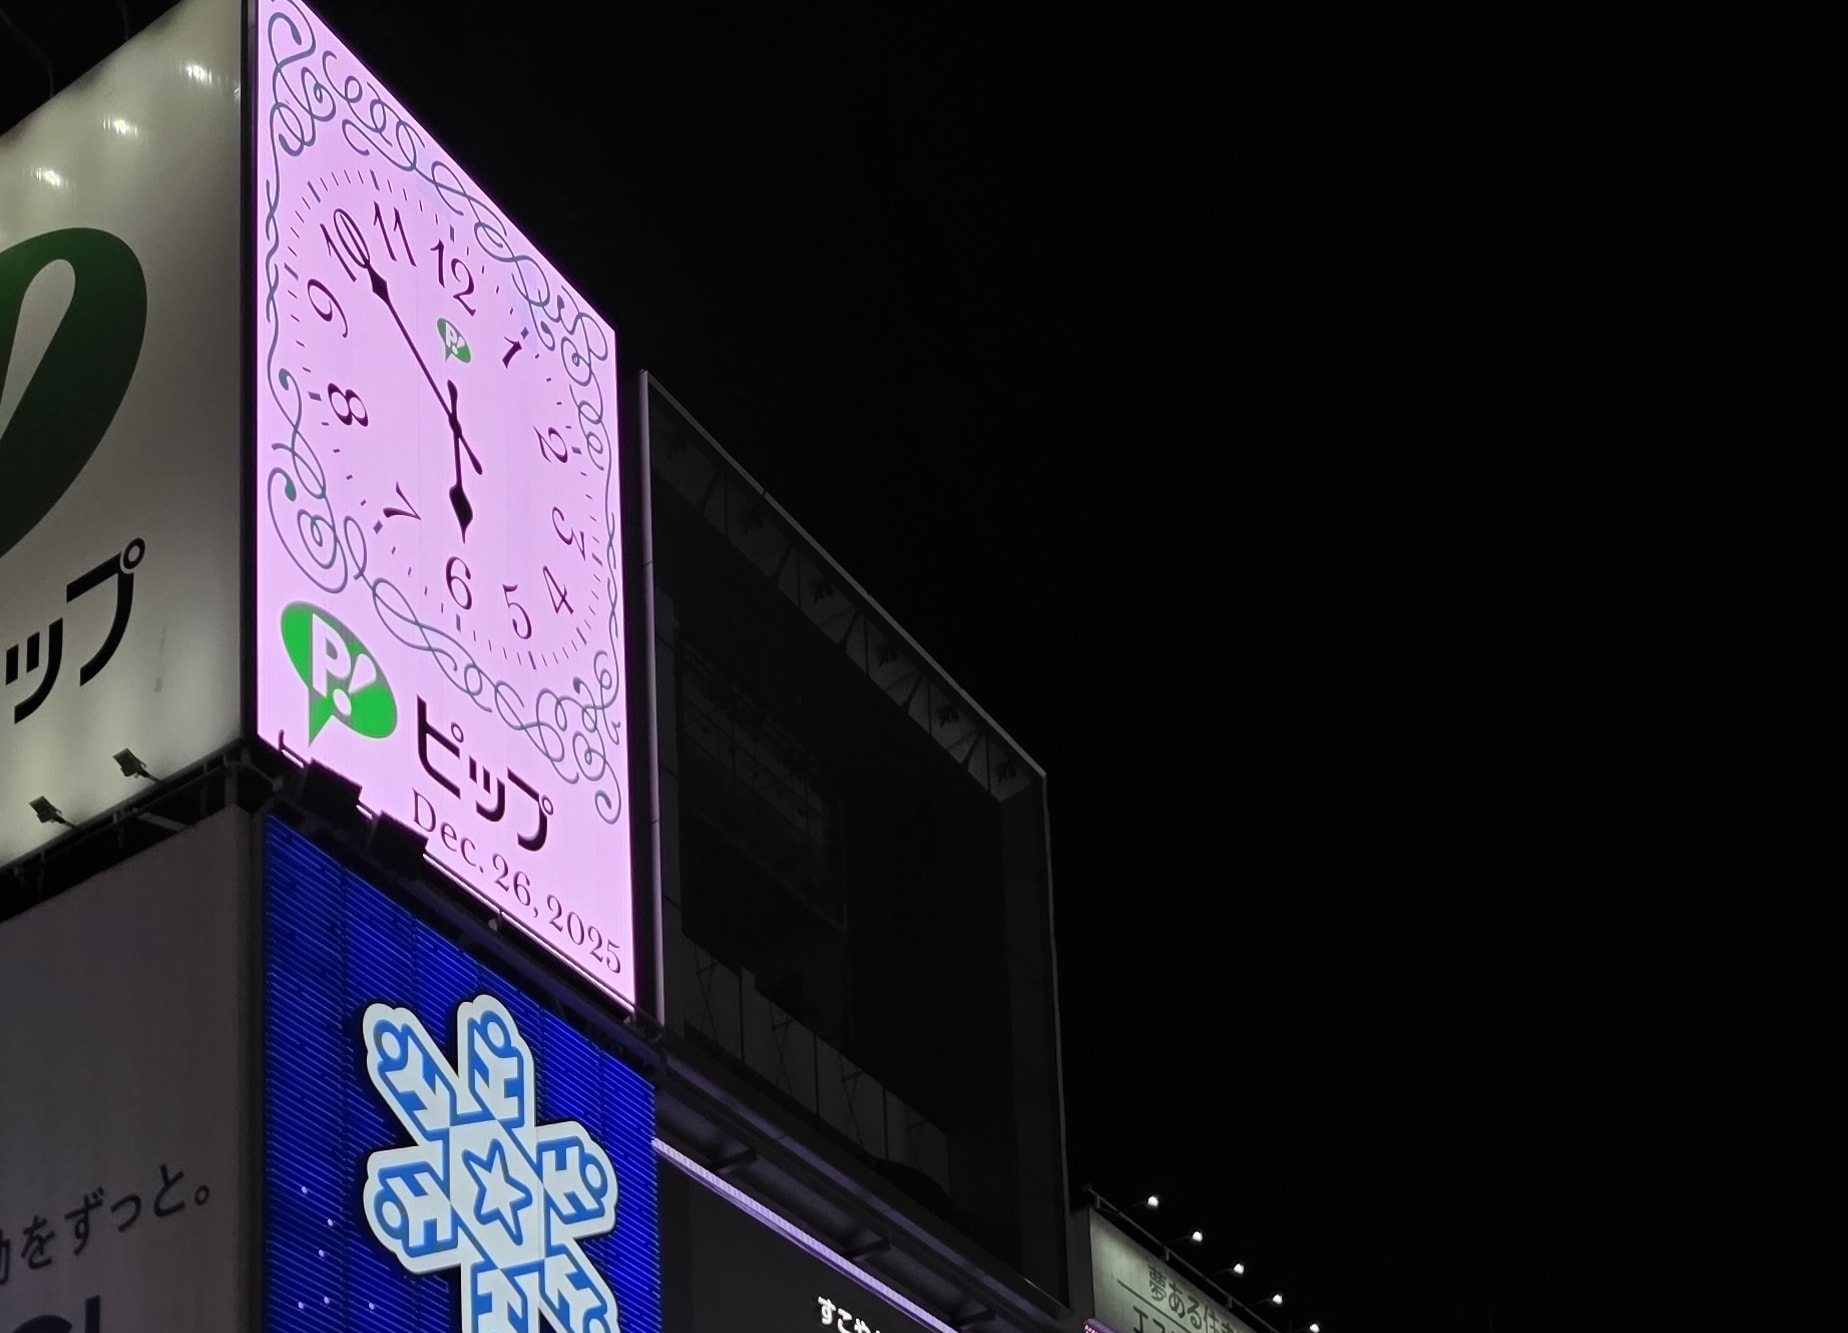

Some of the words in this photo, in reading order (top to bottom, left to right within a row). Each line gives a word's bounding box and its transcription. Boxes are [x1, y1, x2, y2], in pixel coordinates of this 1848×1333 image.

[373, 201, 417, 268] 11
[430, 239, 477, 317] 12
[306, 278, 350, 339] 9
[327, 382, 370, 428] 8
[532, 425, 569, 464] 2
[382, 480, 422, 521] 7
[551, 506, 586, 561] 3
[445, 556, 474, 611] 6
[502, 583, 532, 640] 5
[541, 565, 574, 615] 4
[4, 537, 147, 724] ップ
[416, 693, 555, 852] ピップ
[411, 787, 484, 874] Dec.
[491, 852, 540, 918] 26,
[545, 893, 624, 975] 2025
